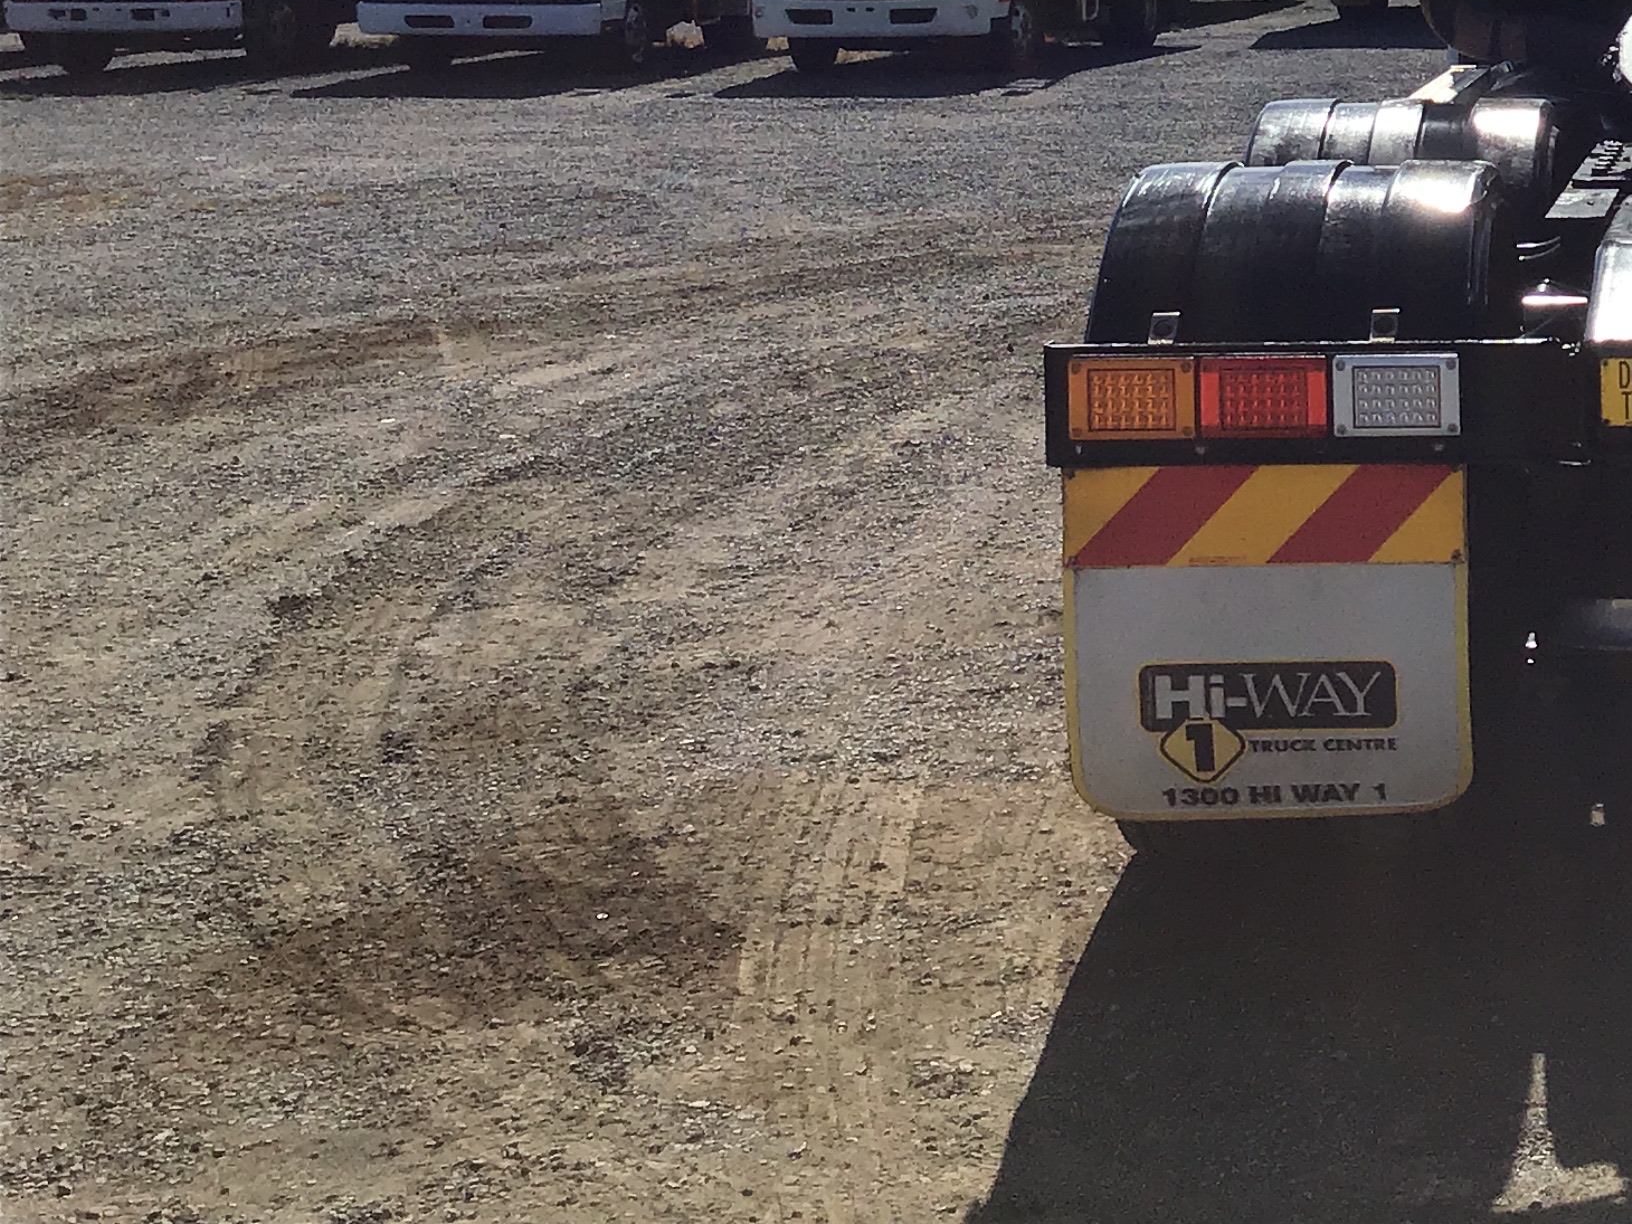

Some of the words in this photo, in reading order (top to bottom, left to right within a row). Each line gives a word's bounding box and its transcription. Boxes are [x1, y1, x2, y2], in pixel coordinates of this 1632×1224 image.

[1185, 723, 1216, 773] 1
[1249, 738, 1317, 753] TRUCK
[1322, 737, 1398, 752] CENTRE
[1162, 786, 1240, 807] 1300
[1249, 785, 1282, 804] HI
[1292, 783, 1361, 803] WAY
[1371, 783, 1388, 801] 1
